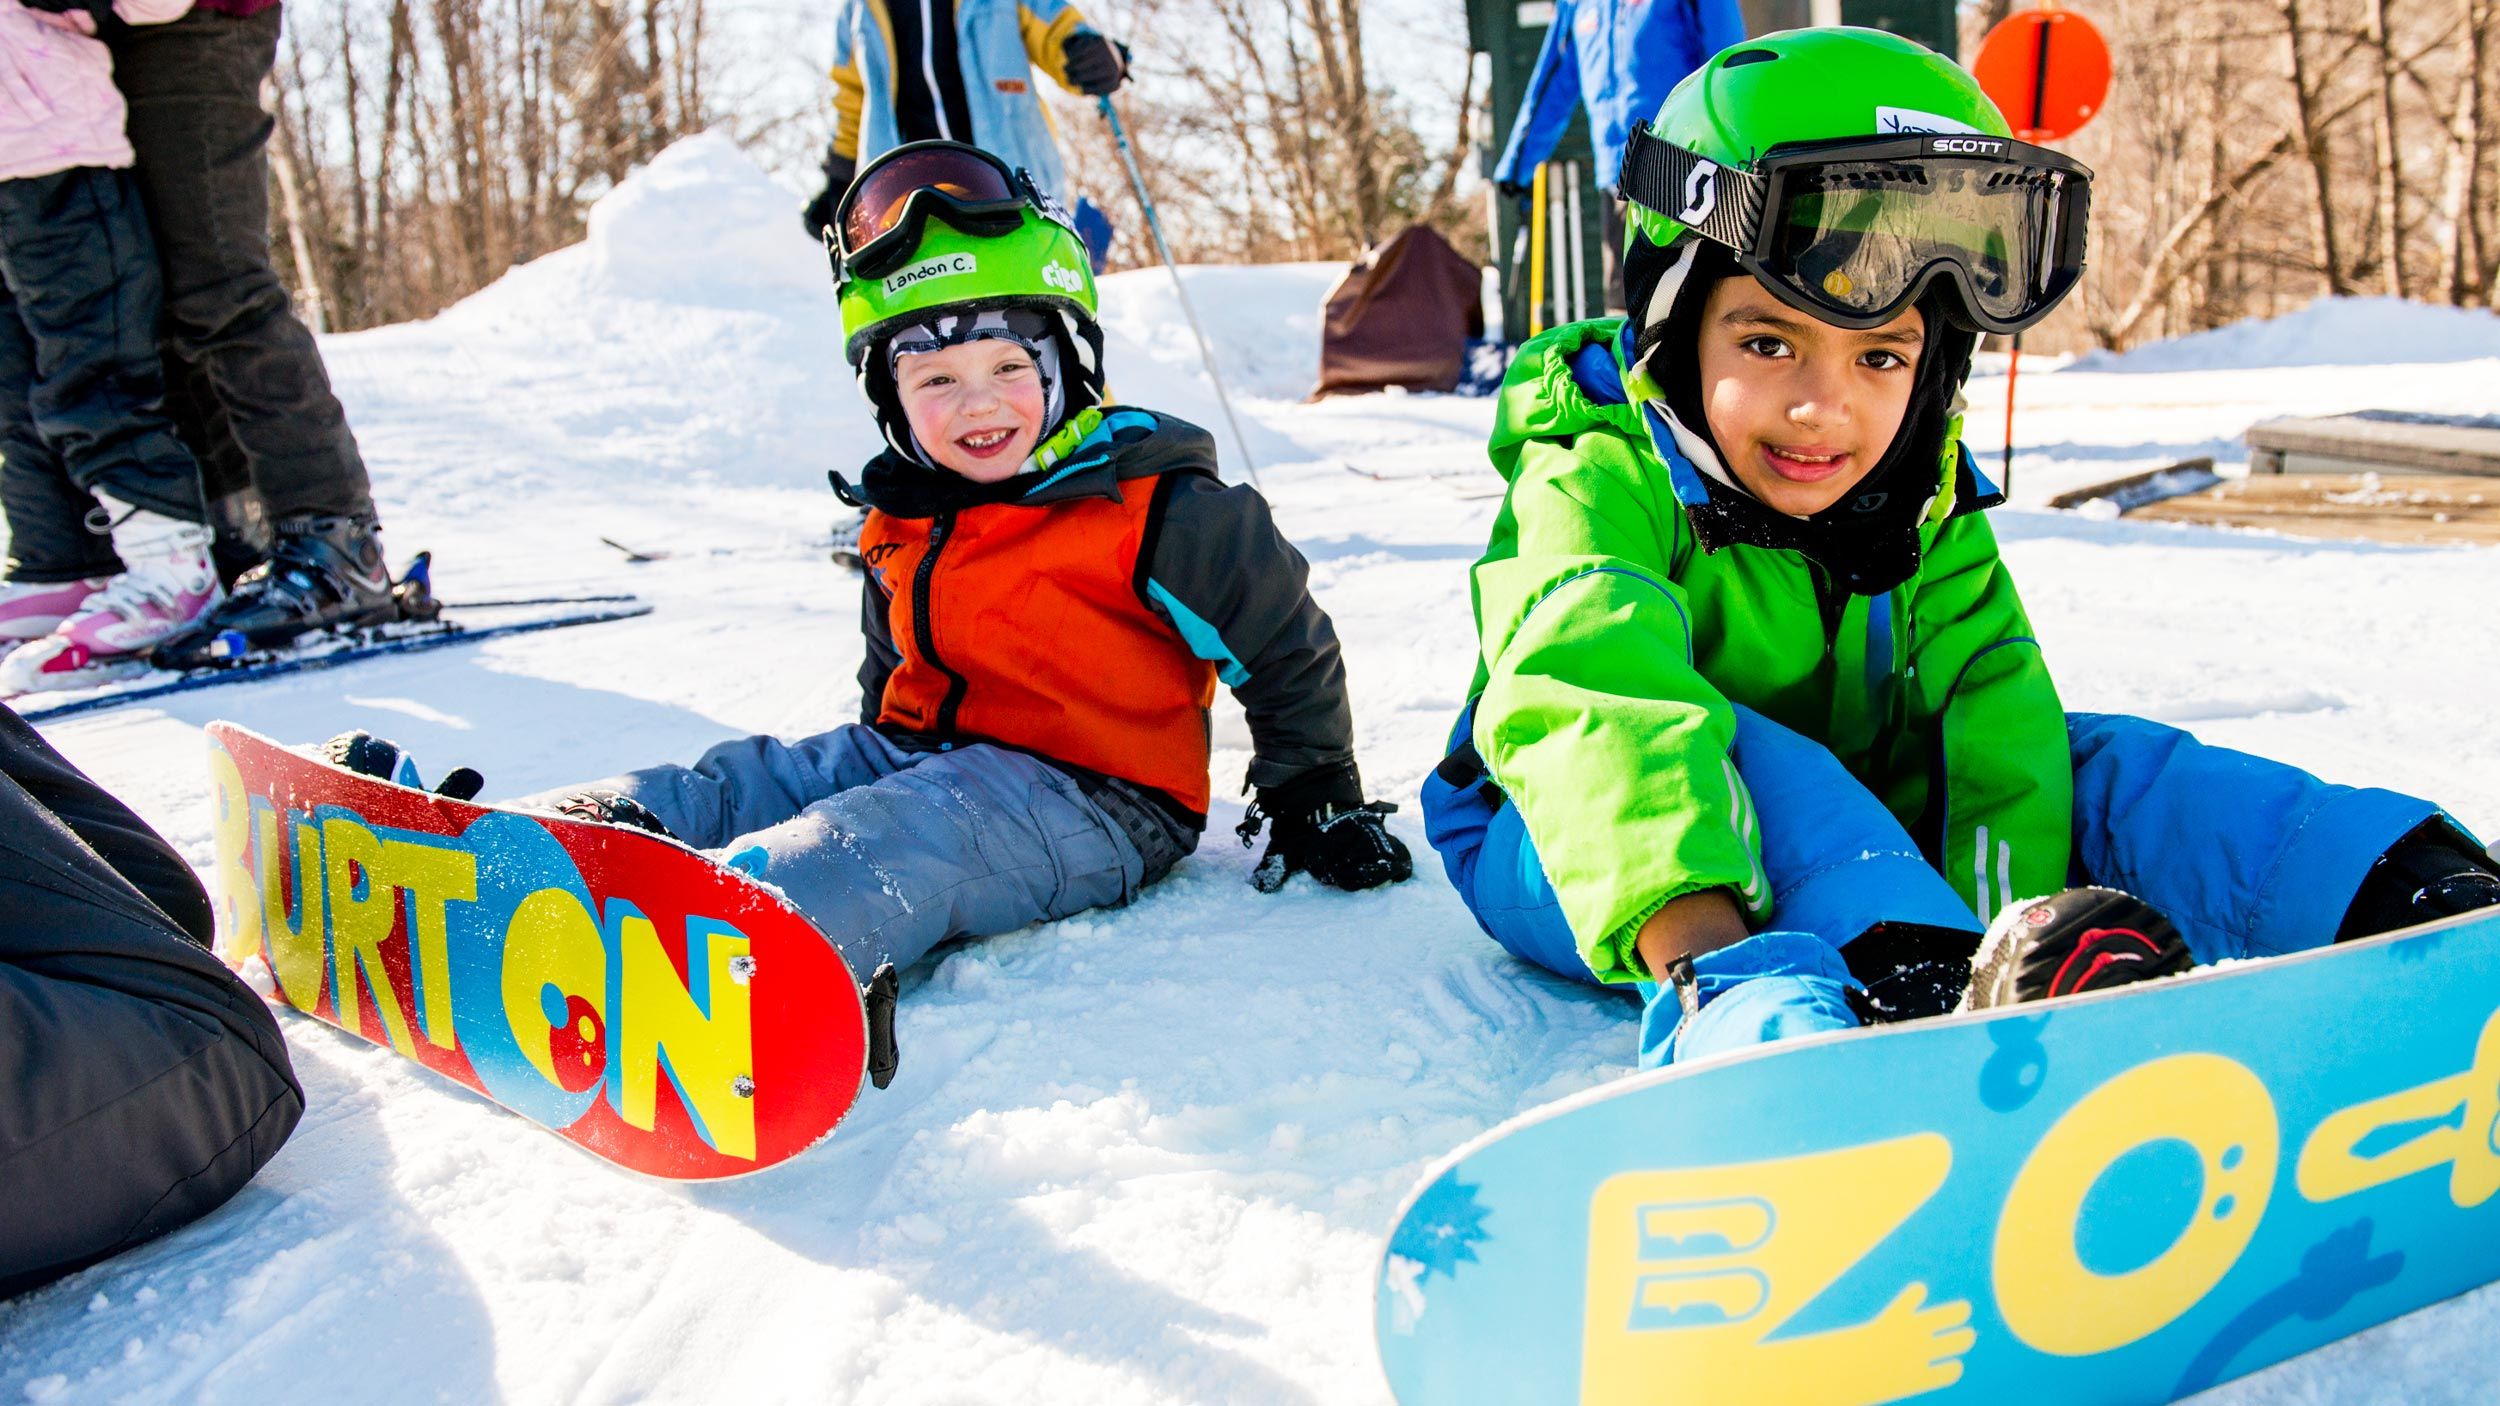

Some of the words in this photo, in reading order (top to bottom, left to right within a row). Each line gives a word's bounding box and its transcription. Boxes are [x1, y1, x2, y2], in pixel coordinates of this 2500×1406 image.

[1932, 138, 2003, 154] SCOTT
[886, 263, 948, 293] Landon
[953, 257, 973, 272] C.
[207, 745, 757, 1161] BURTON
